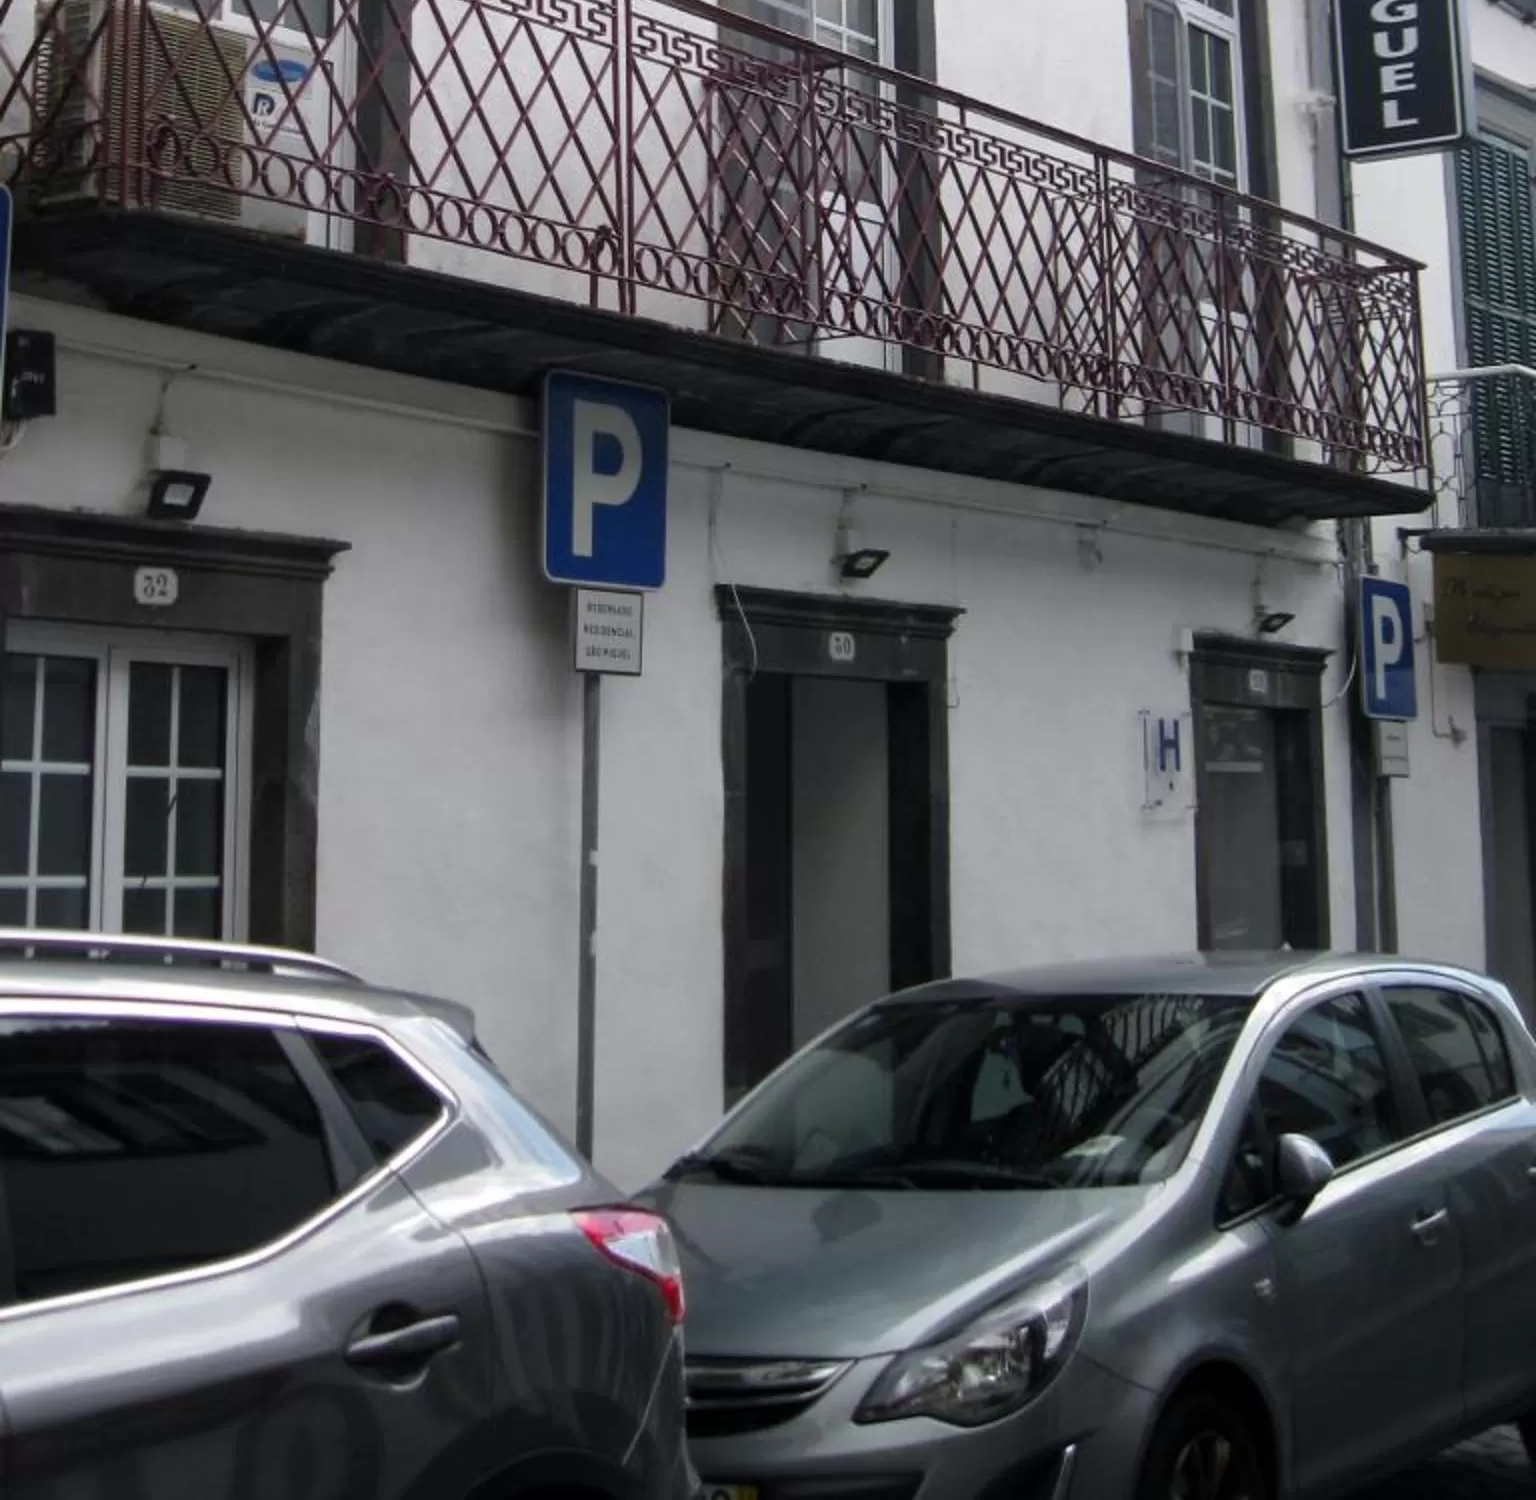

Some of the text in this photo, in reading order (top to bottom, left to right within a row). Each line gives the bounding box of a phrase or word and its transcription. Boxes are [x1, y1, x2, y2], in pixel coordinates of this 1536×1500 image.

[572, 399, 643, 557] P
[1372, 595, 1404, 699] P
[1158, 716, 1181, 773] H
